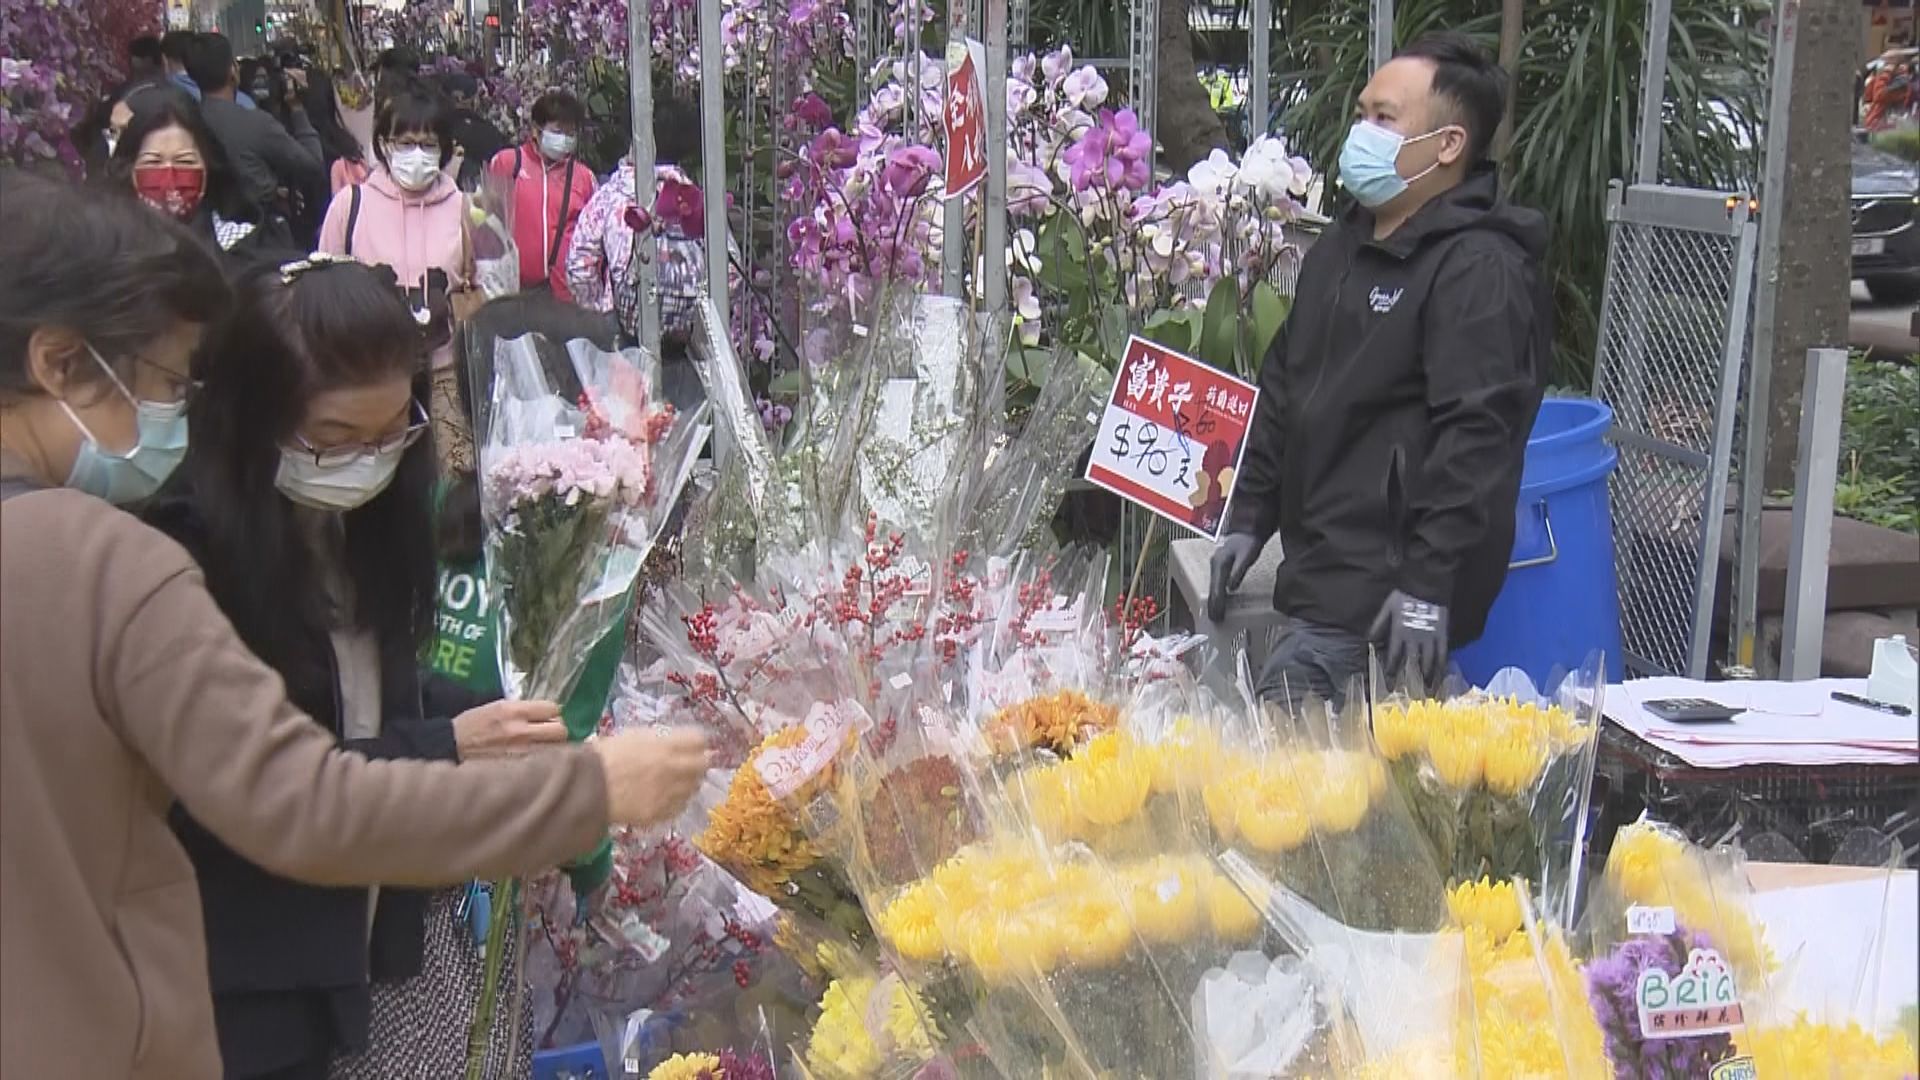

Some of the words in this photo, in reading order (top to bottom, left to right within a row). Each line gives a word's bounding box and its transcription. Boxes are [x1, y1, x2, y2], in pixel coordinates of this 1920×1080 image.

[1126, 352, 1194, 413] 富貴子
[463, 623, 488, 640] OF
